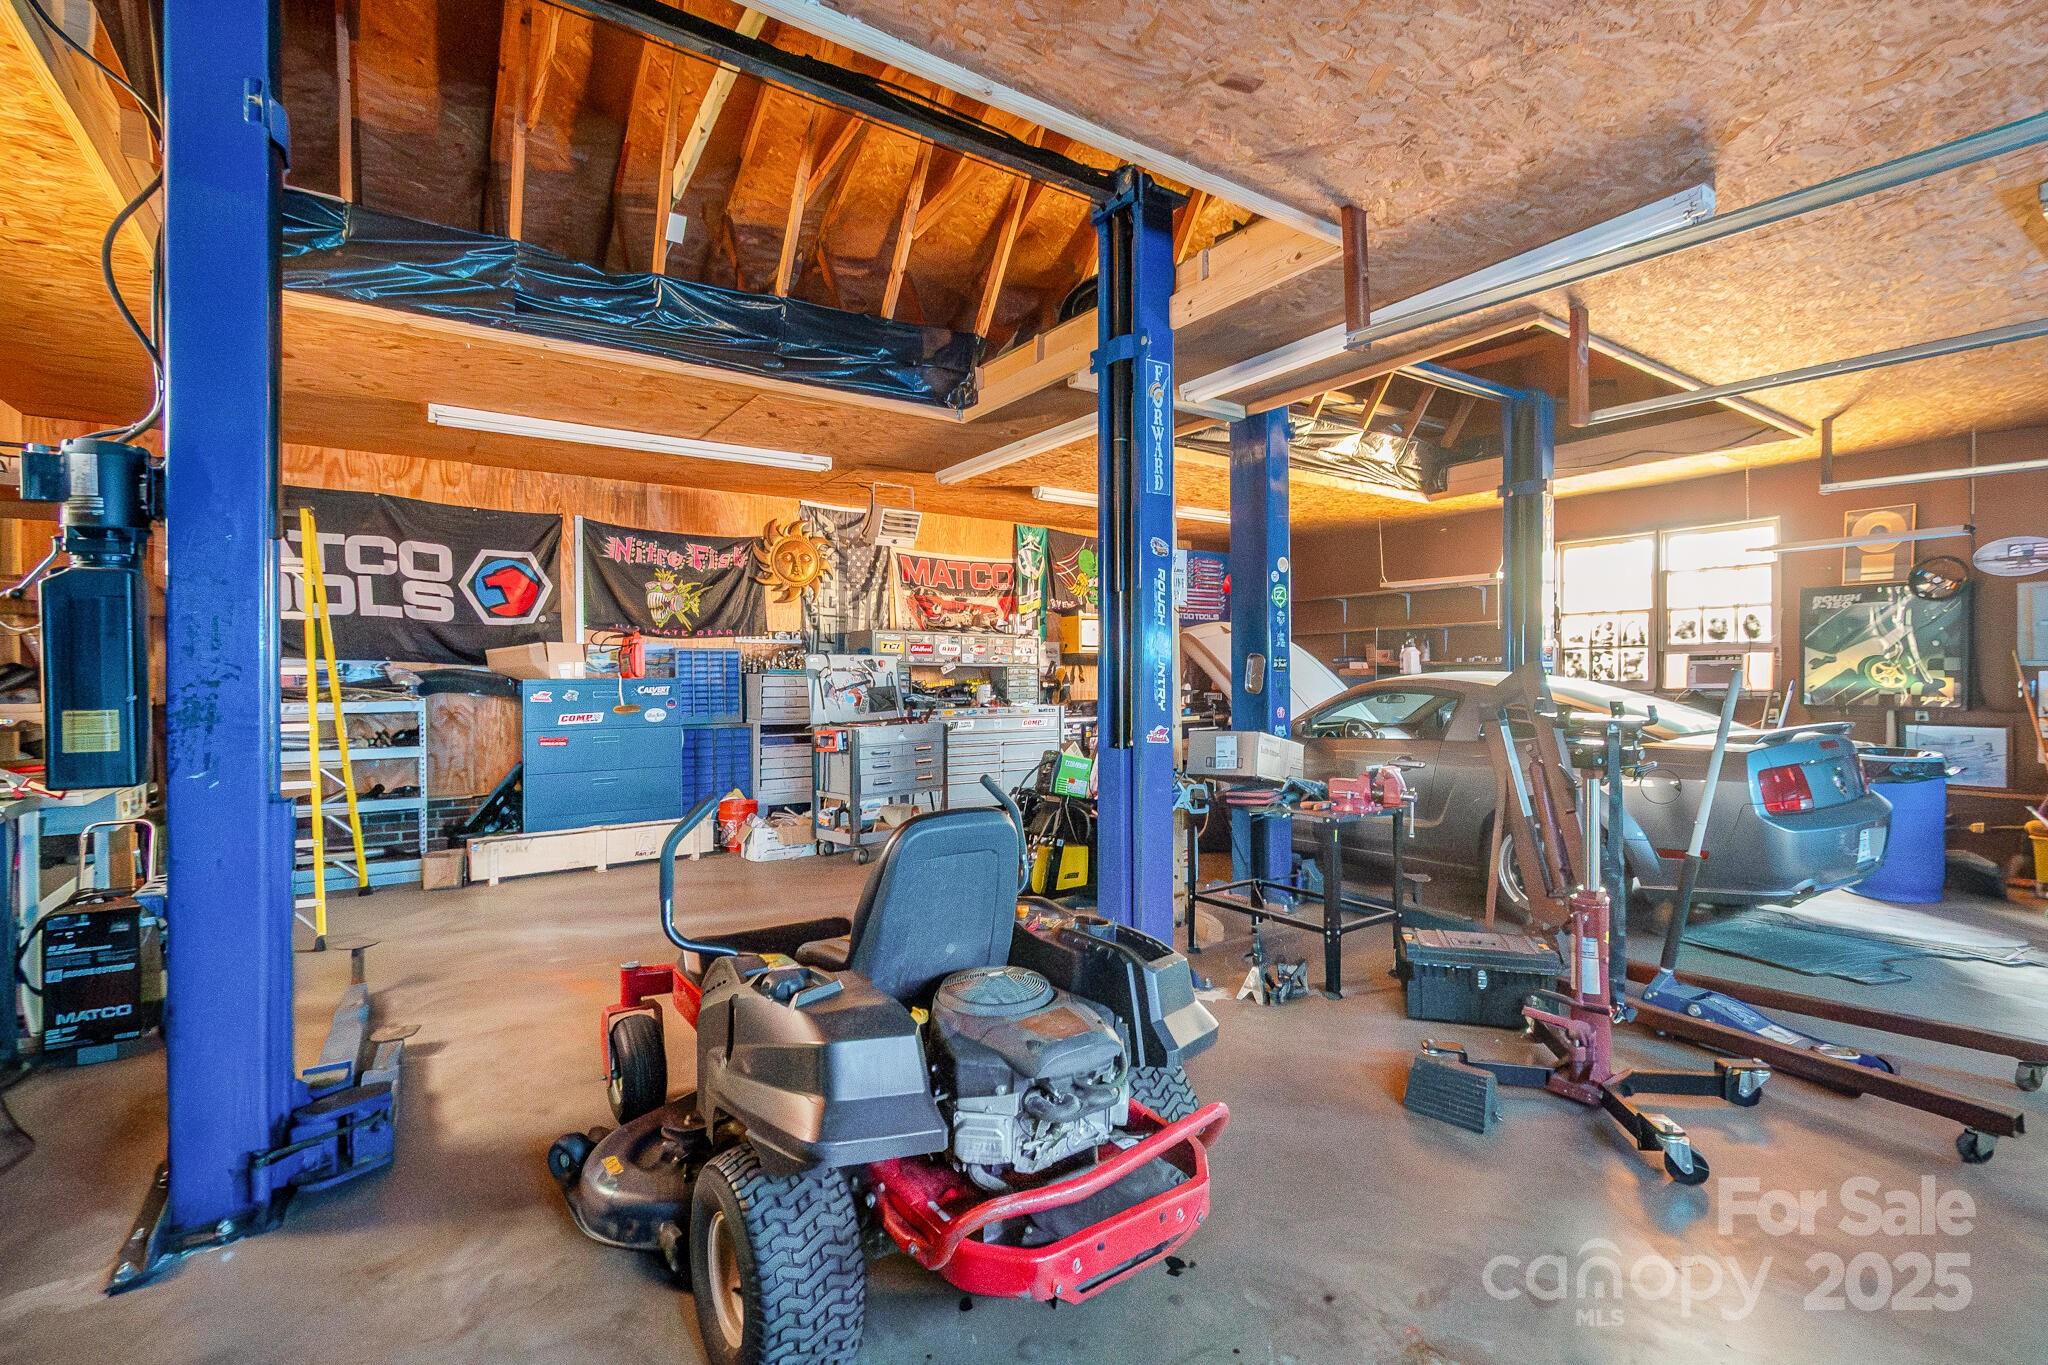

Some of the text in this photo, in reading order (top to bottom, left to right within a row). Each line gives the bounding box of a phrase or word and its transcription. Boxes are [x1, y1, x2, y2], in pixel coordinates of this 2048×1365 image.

[1150, 364, 1166, 491] FORWARD
[605, 536, 686, 570] Nitro
[900, 555, 1014, 590] MATCO
[1157, 567, 1166, 626] ROUGH
[638, 685, 671, 694] CALVERT
[560, 714, 593, 723] COMP
[56, 1004, 132, 1025] MATCO
